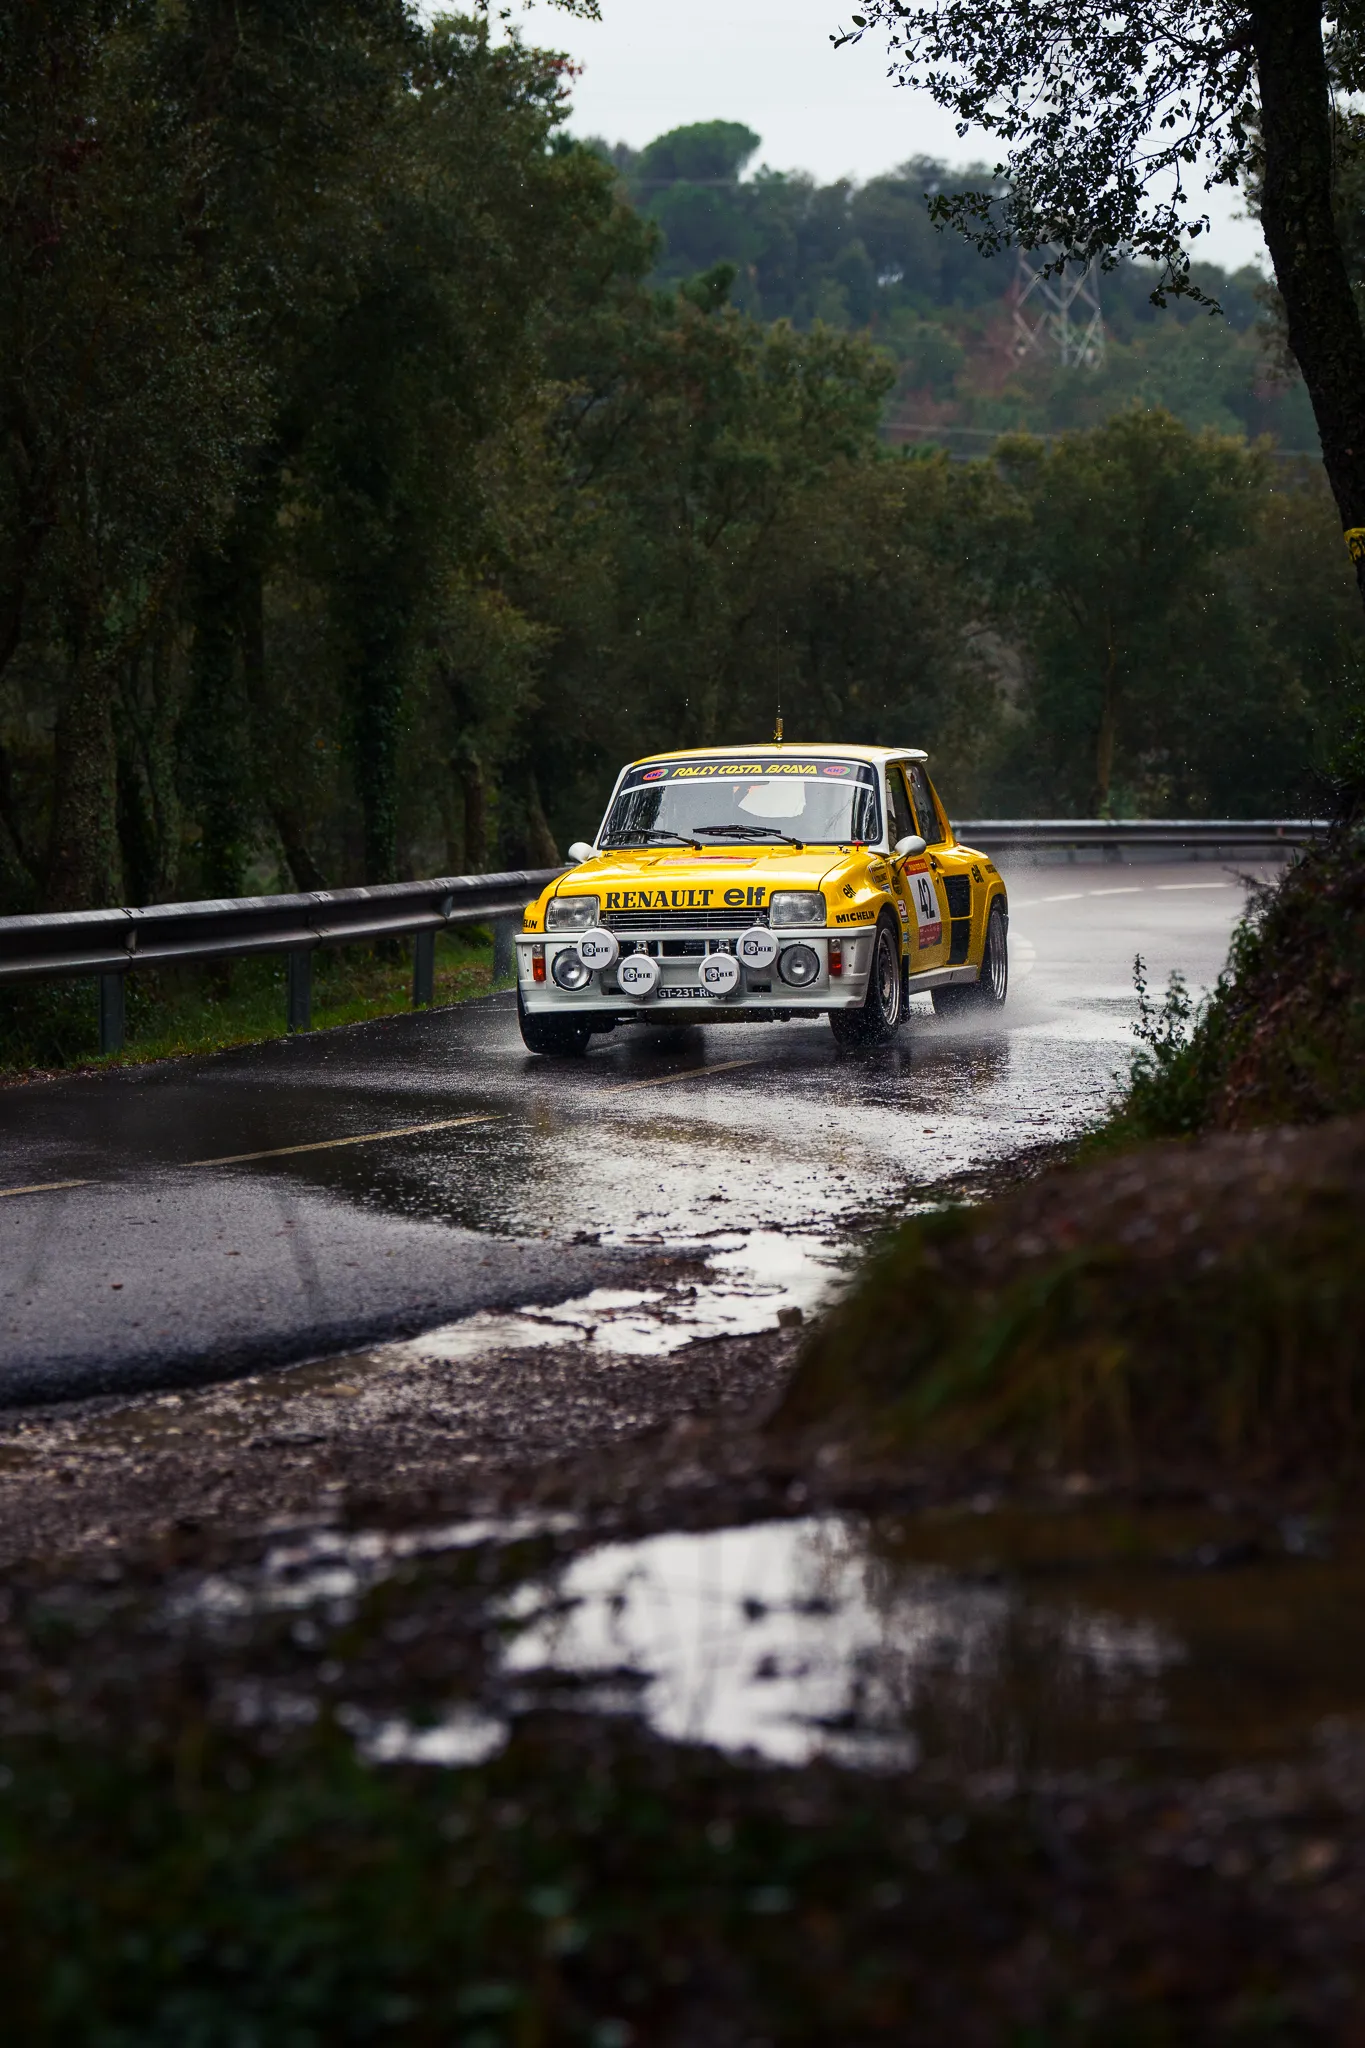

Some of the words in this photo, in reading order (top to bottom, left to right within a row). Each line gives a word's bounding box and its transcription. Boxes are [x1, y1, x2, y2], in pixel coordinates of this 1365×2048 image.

[671, 766, 719, 777] RALLY
[718, 764, 763, 774] COSTA
[765, 764, 818, 774] BRAVA
[605, 889, 714, 909] RENAULT
[723, 886, 766, 907] elf
[842, 883, 857, 899] elf
[917, 878, 936, 920] 42
[836, 911, 876, 924] MICHELIN
